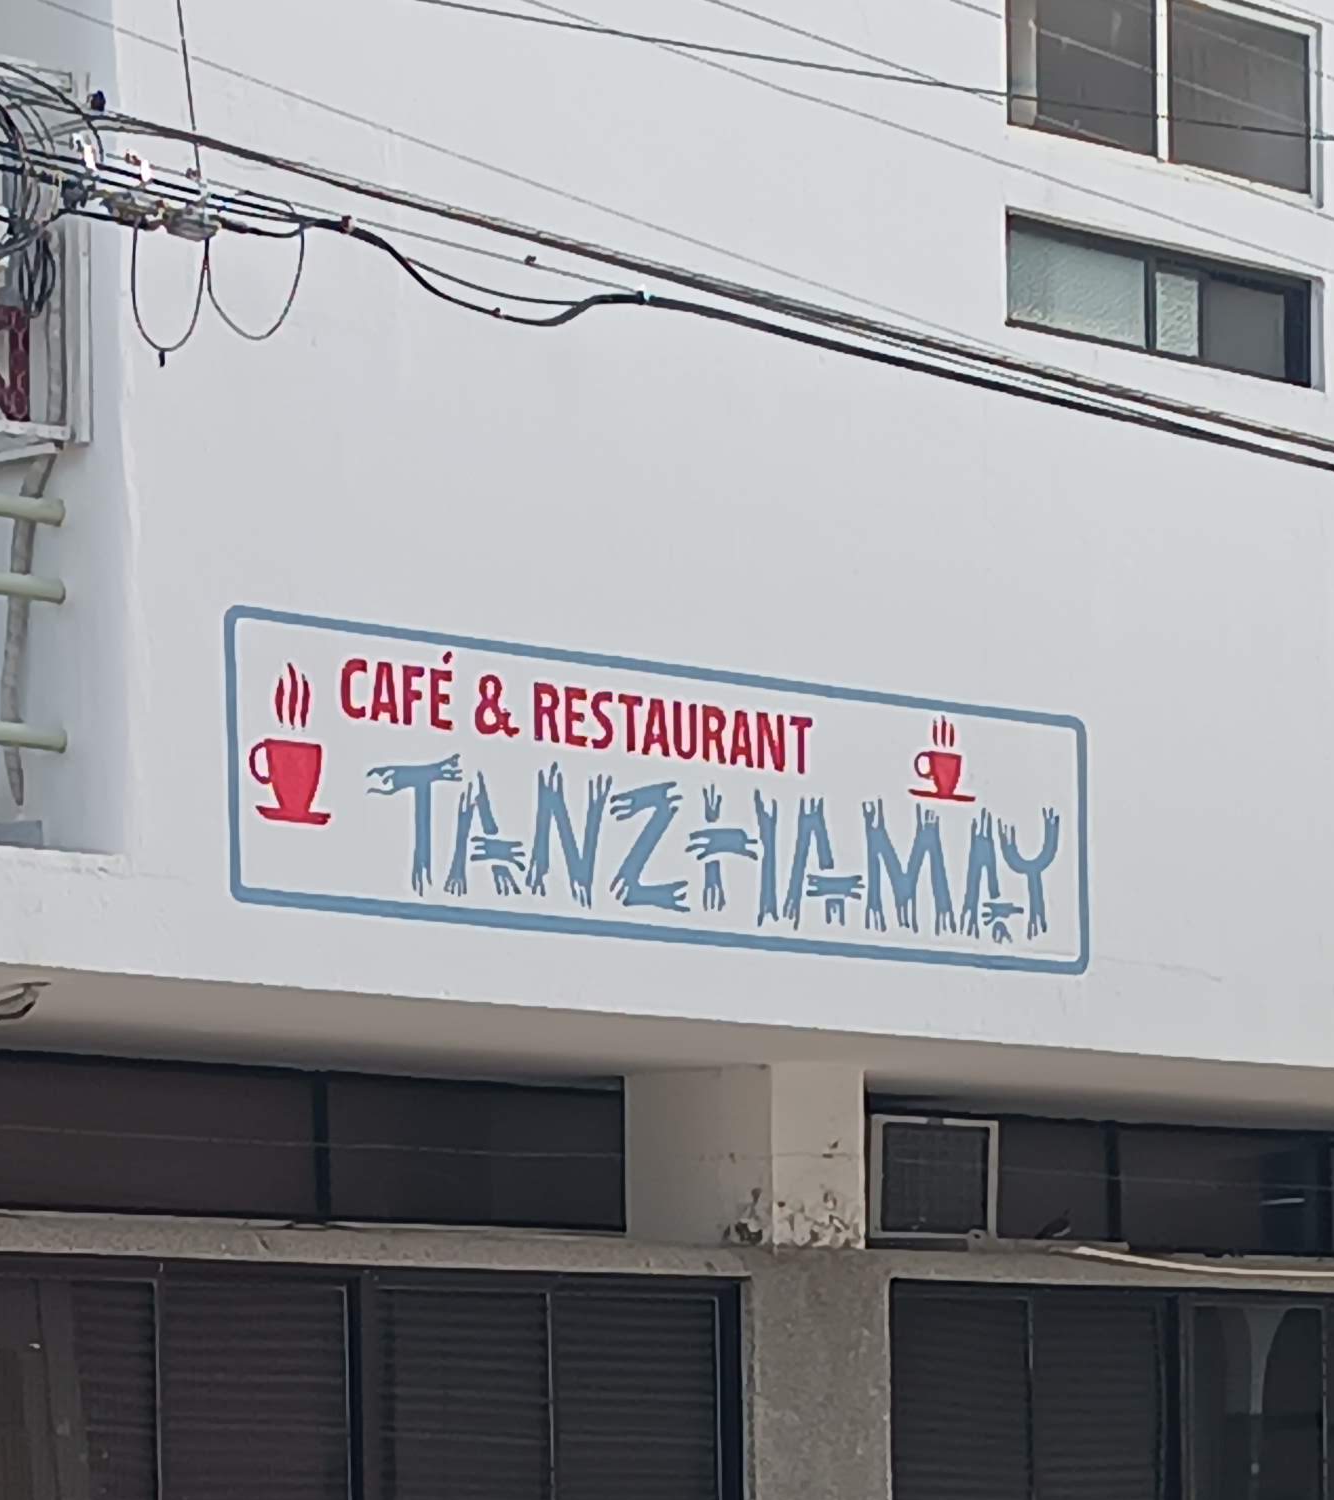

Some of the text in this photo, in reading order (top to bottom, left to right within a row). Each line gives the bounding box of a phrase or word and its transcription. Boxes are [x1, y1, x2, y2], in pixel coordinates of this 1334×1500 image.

[340, 651, 813, 775] CAFÉ & RESTAURANT
